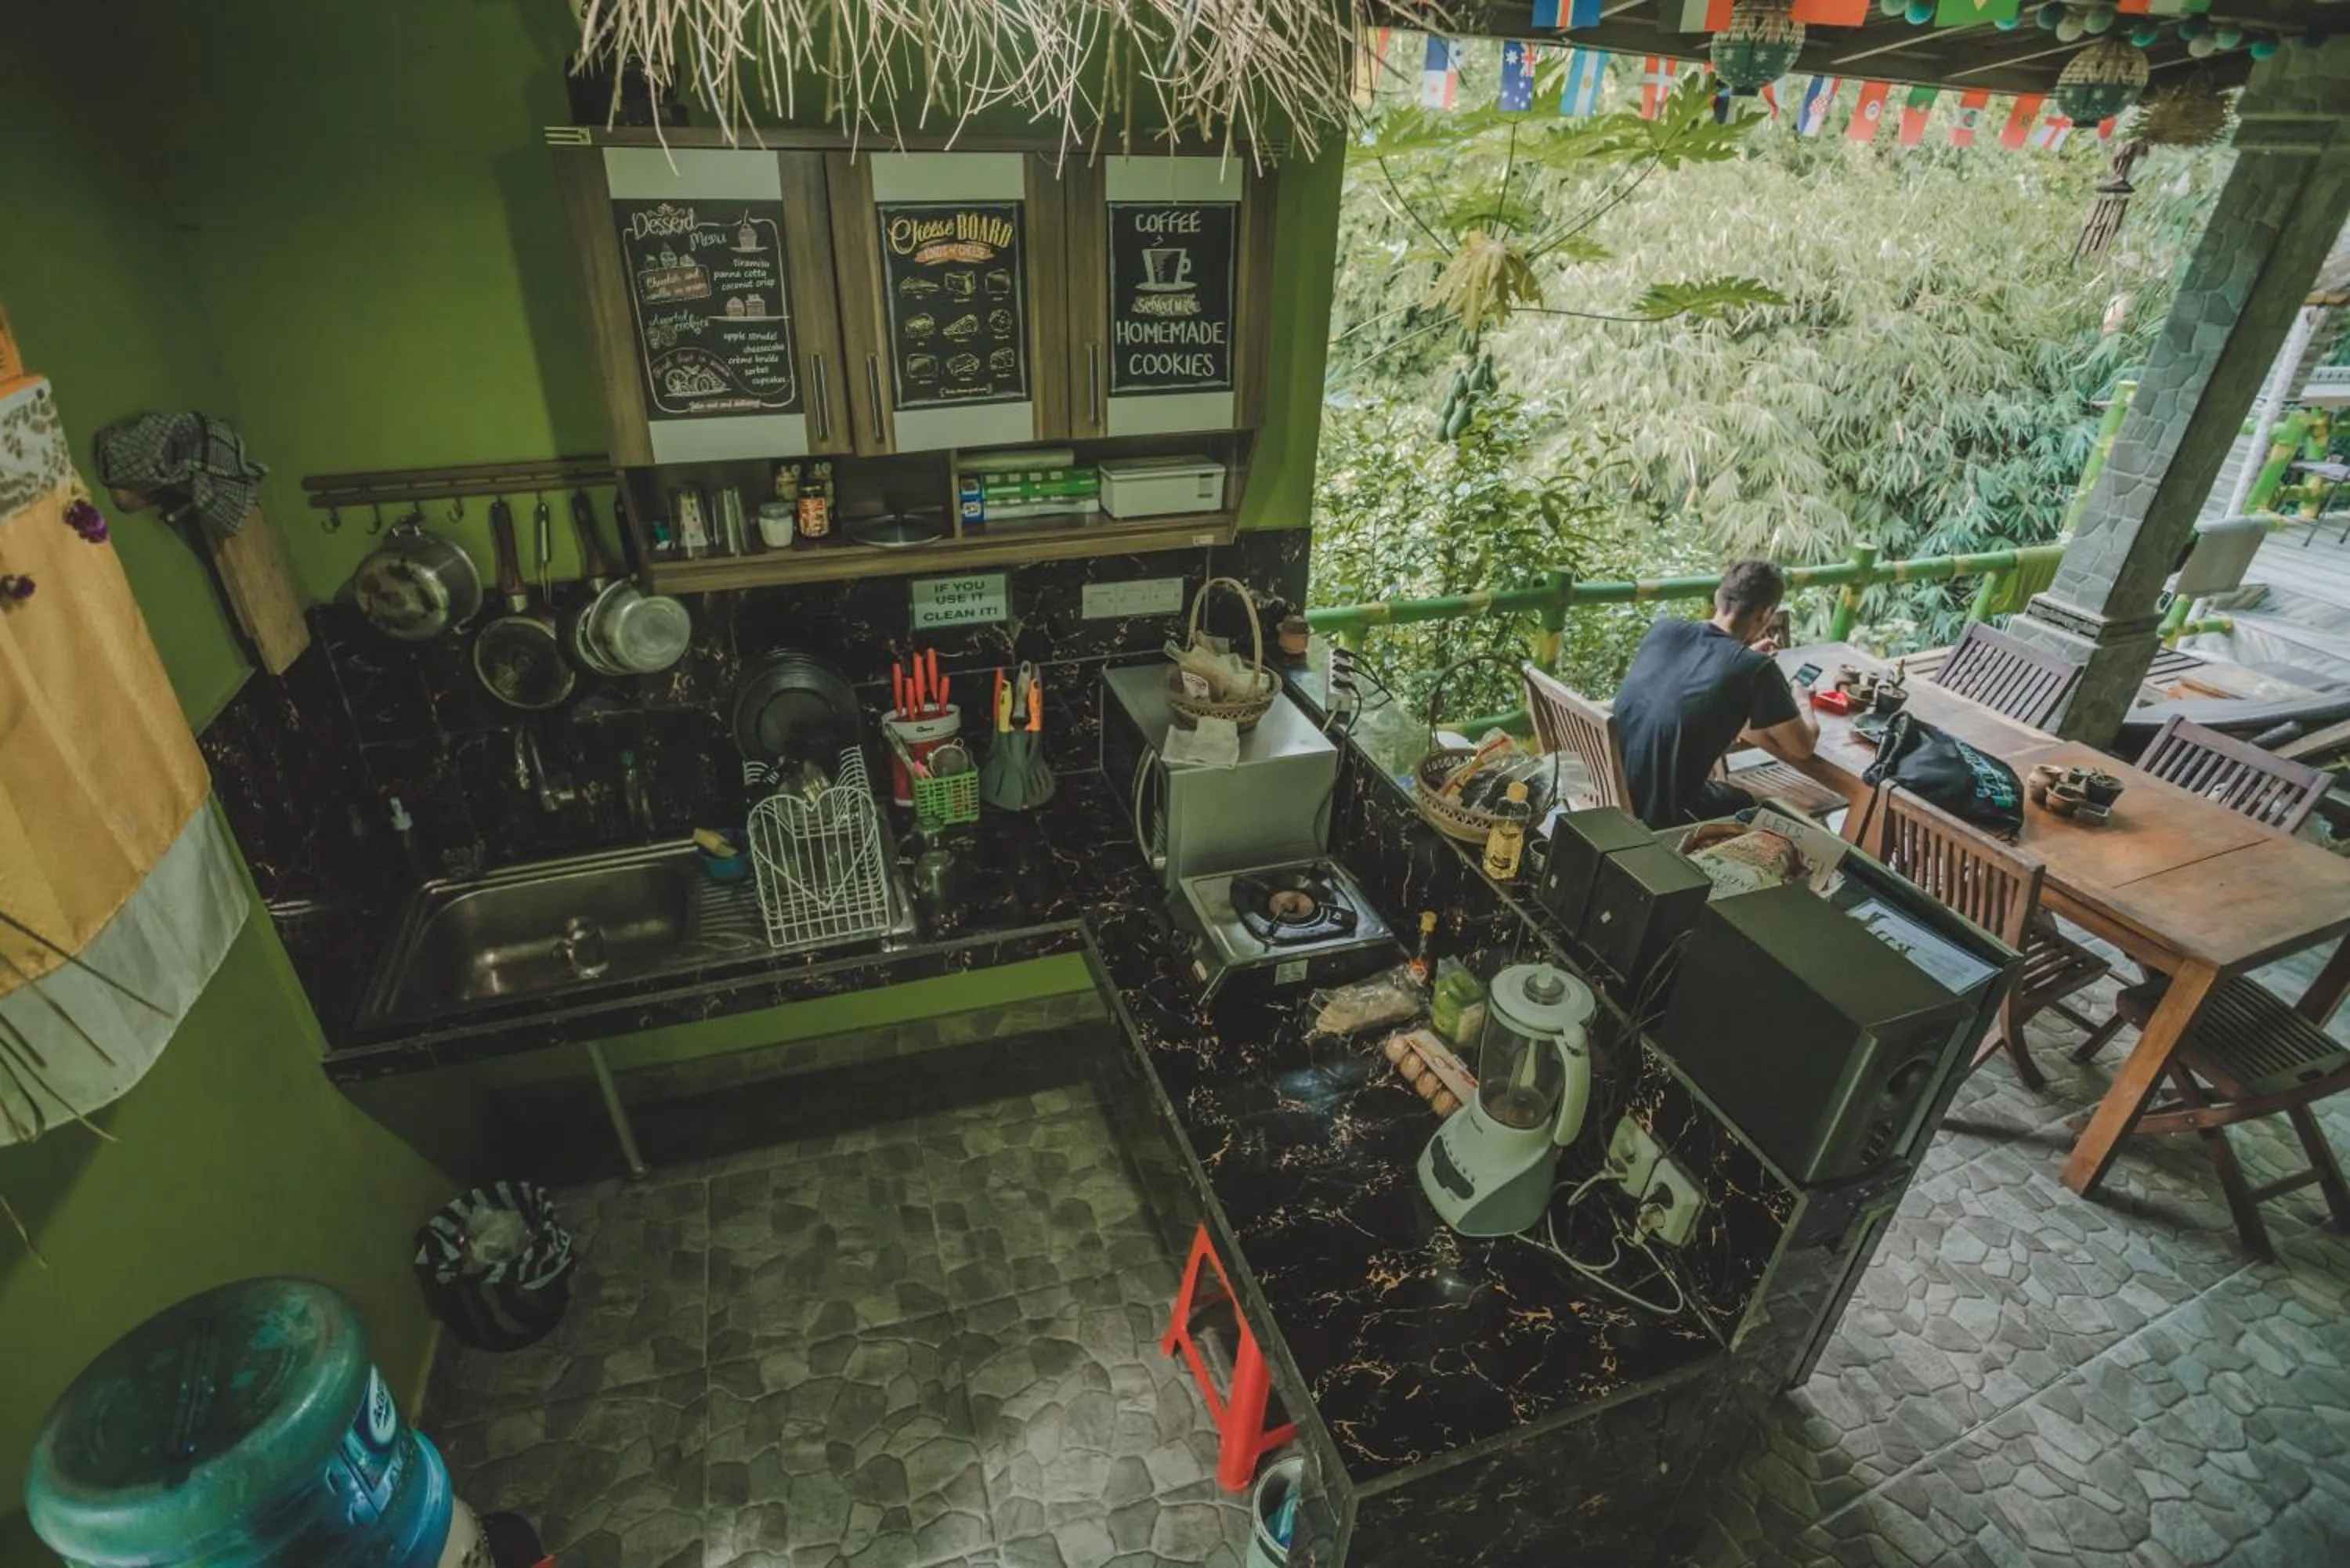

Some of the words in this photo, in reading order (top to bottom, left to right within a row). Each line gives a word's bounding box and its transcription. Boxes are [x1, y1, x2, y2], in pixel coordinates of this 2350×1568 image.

[1135, 211, 1201, 233] COFFEE
[689, 231, 728, 251] Menu
[888, 215, 955, 255] Cheese
[956, 212, 1014, 249] BOARD
[743, 269, 766, 277] cotta
[1116, 320, 1226, 345] HOMEMADE
[1129, 353, 1215, 377] COOKIES
[934, 583, 950, 594] IF
[953, 580, 985, 591] YOU
[935, 594, 966, 605] USE
[971, 592, 983, 602] IT
[923, 609, 975, 622] CLEAN
[980, 605, 998, 616] IT!
